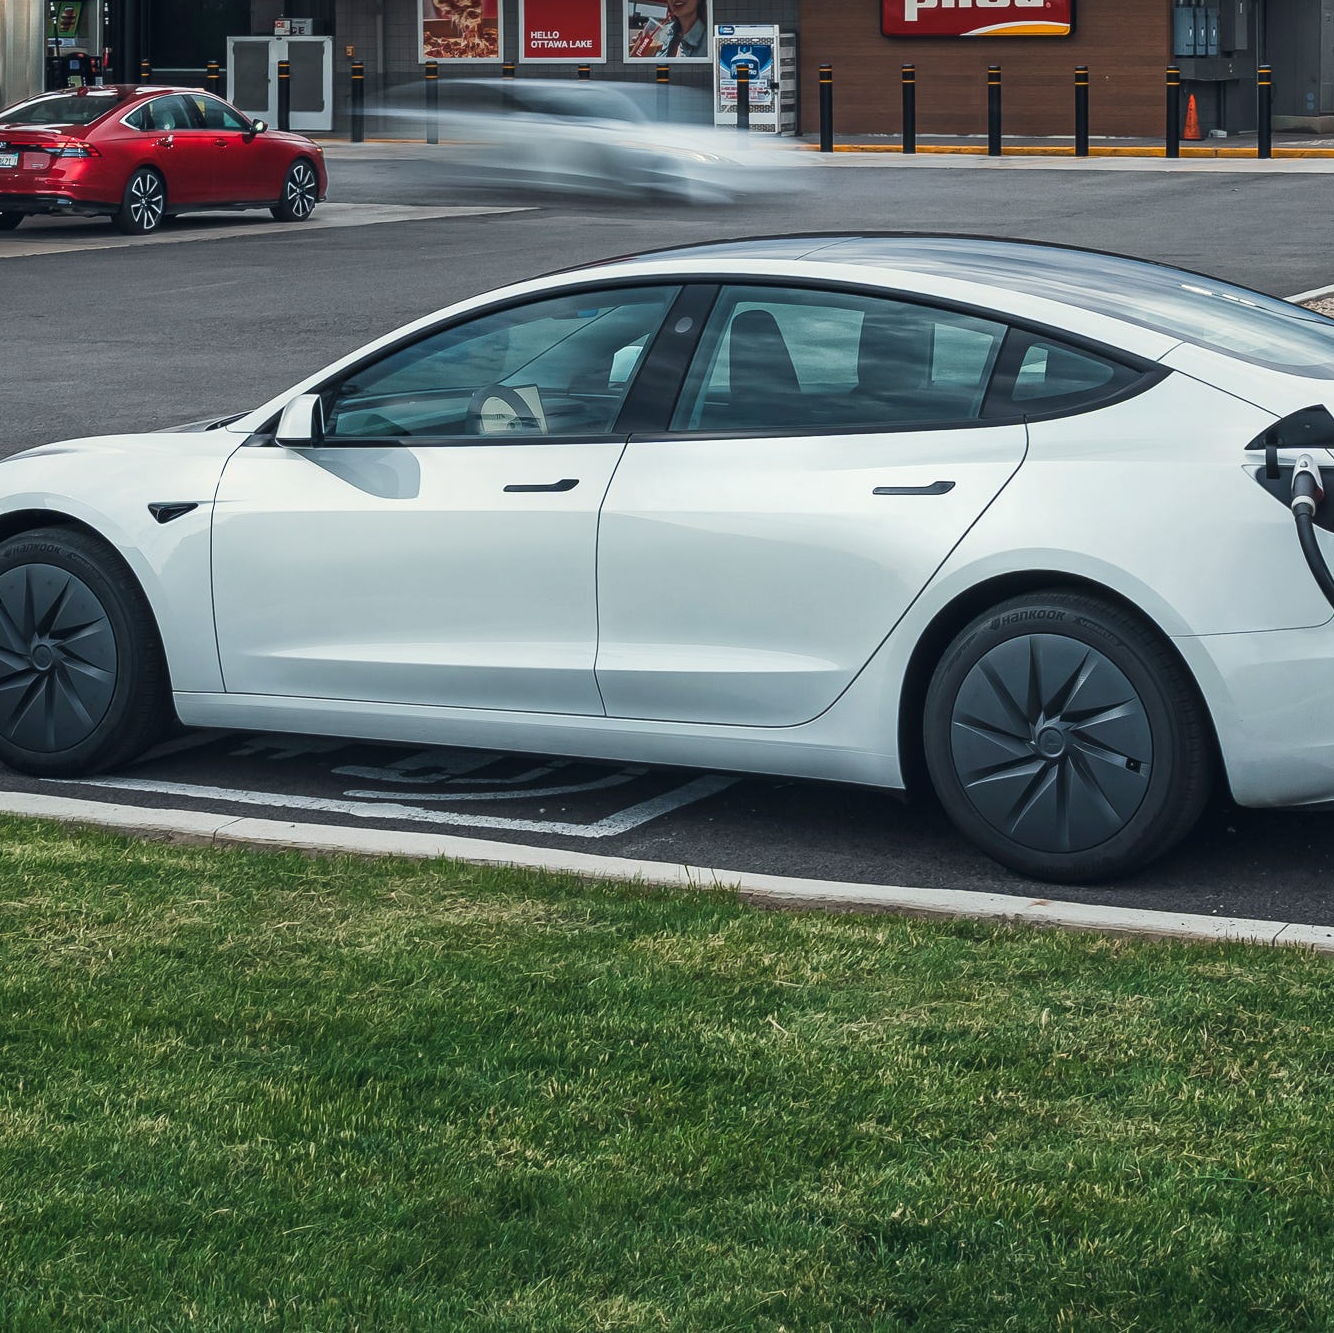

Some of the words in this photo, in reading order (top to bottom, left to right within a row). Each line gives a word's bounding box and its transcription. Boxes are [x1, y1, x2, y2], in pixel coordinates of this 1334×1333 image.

[530, 31, 560, 39] HELLO
[530, 40, 568, 49] OTTAWA
[569, 40, 593, 48] LAKE
